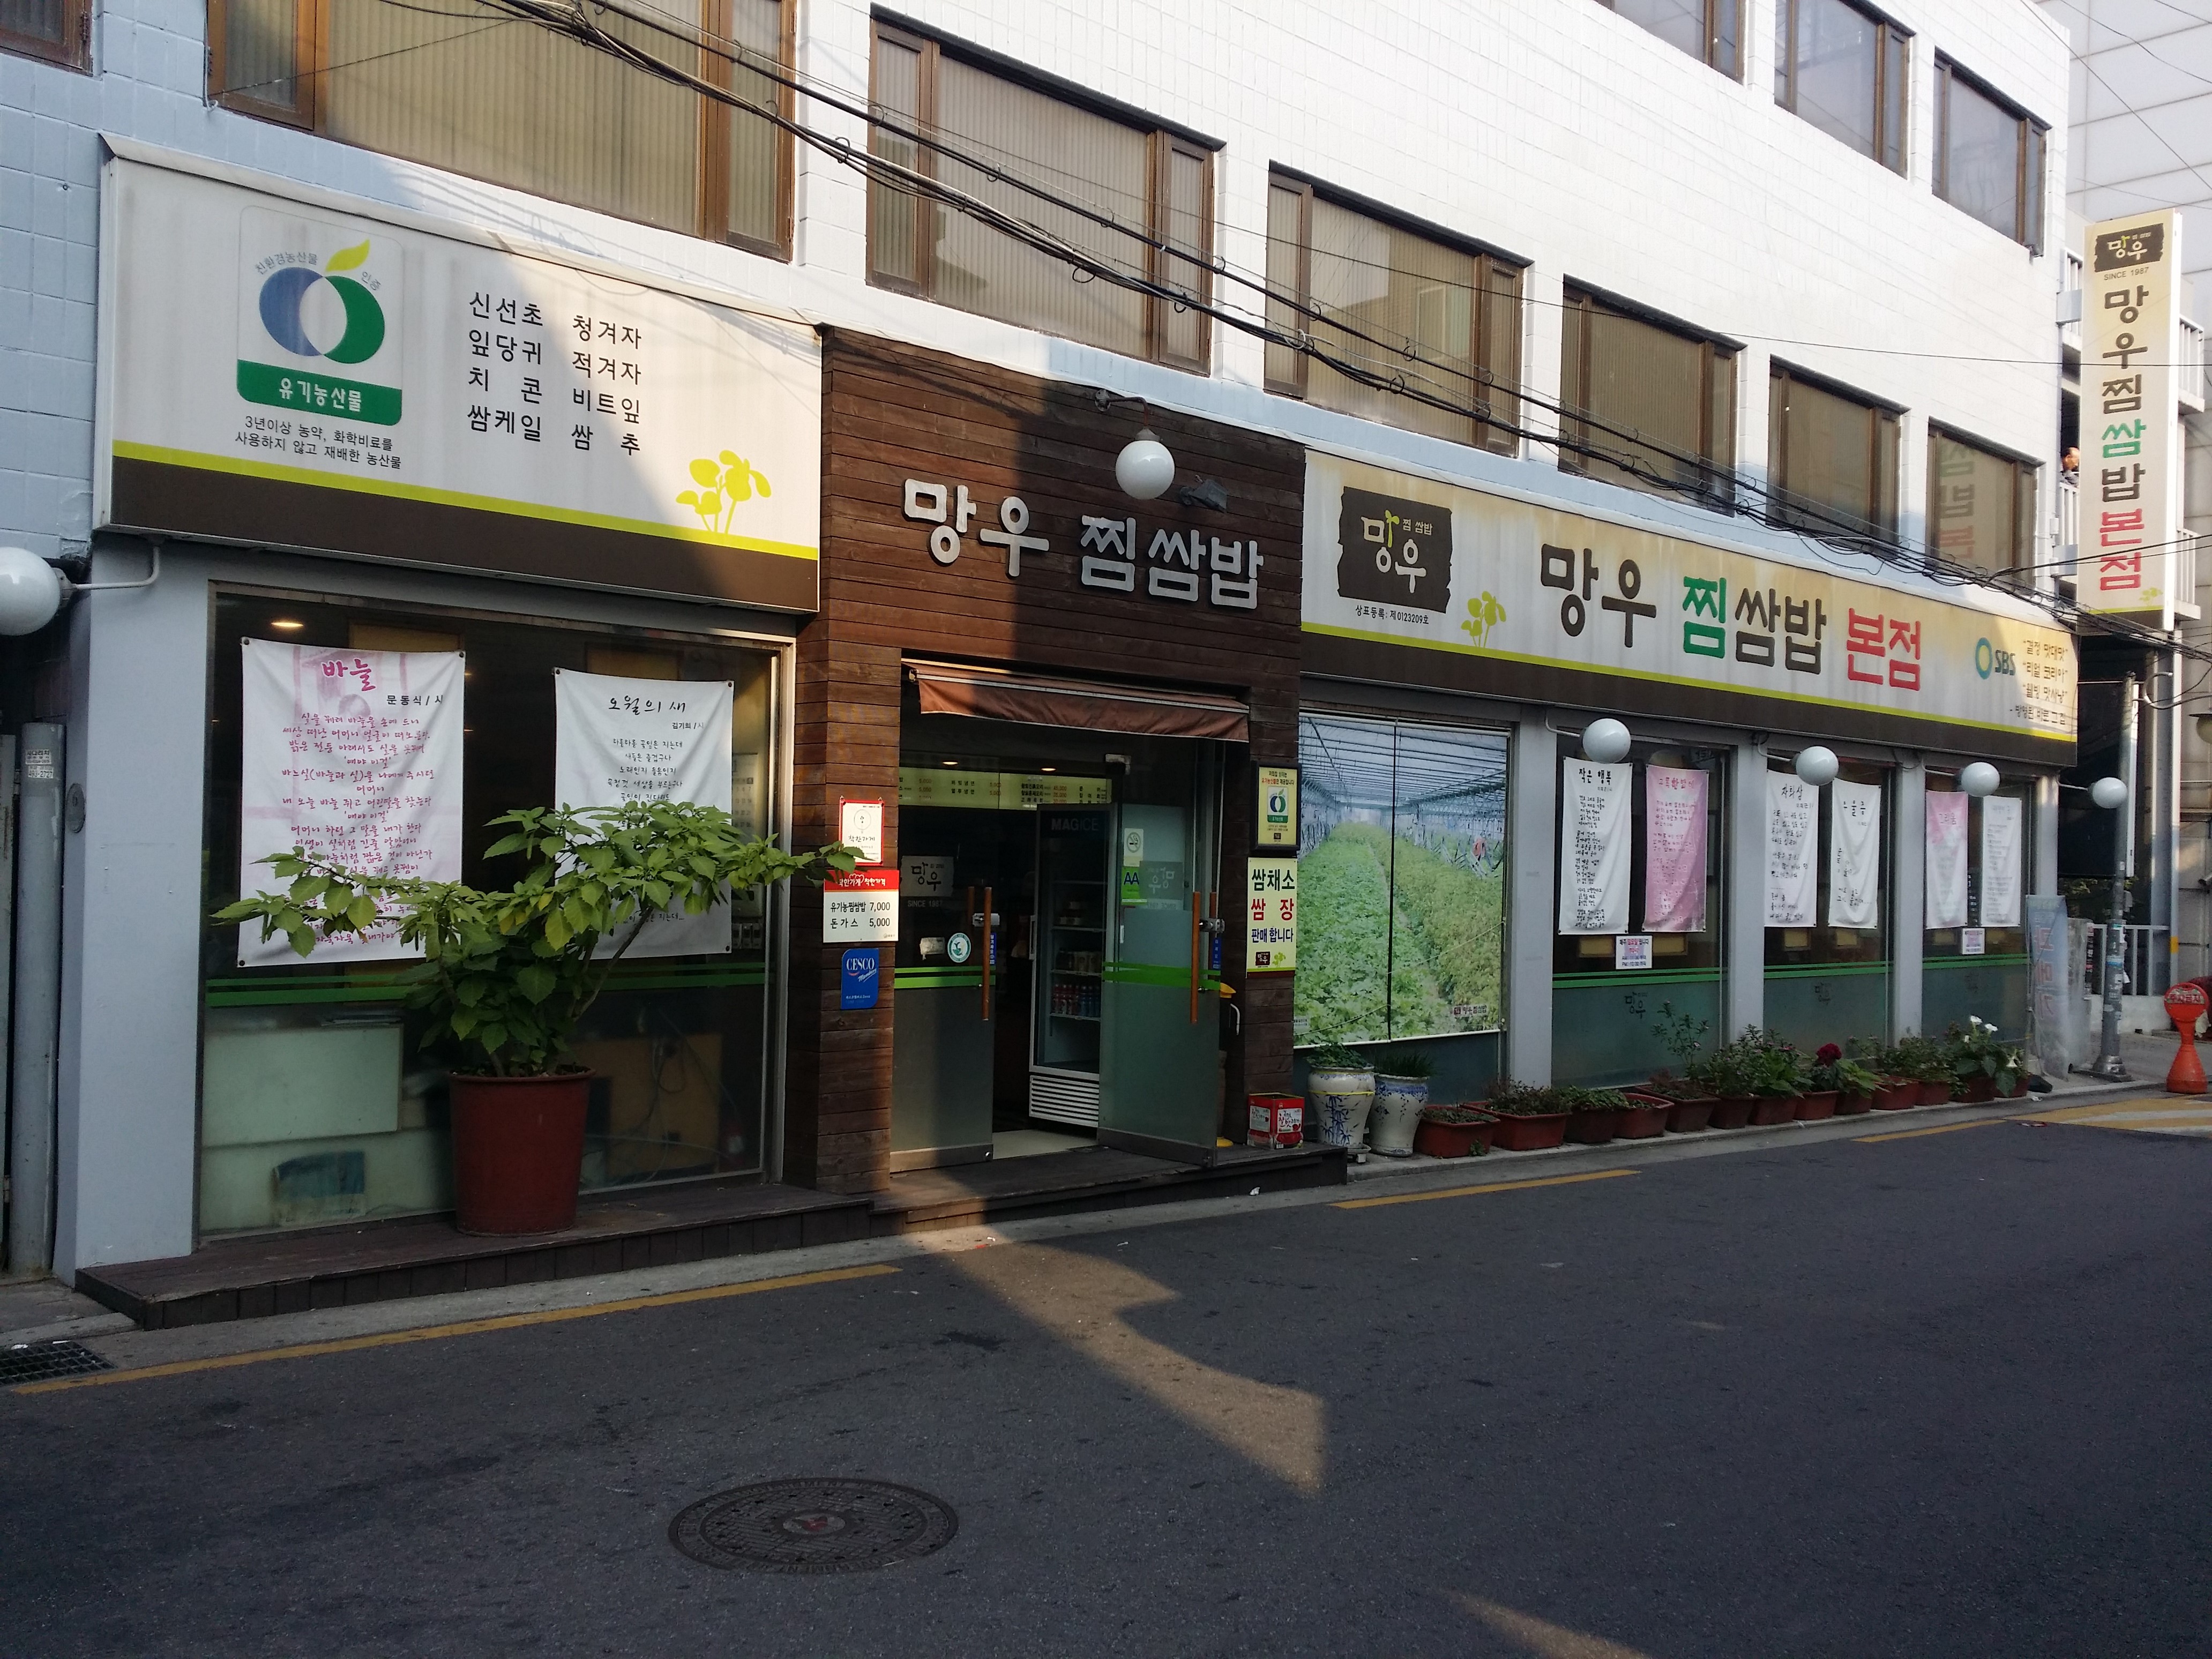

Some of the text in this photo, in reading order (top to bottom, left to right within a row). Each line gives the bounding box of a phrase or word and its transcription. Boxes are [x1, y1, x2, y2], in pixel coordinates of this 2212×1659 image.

[2108, 235, 2147, 260] 망우
[2104, 267, 2149, 280] SINCE 1987
[469, 292, 642, 350] 신선초 청겨자
[469, 329, 642, 386] 잎당귀 적겨자
[279, 377, 363, 413] 유기농산물
[573, 388, 641, 425] 비트잎
[245, 415, 393, 451] 3년이상 농약, 화학비료를
[467, 405, 541, 443] 쌈케일
[235, 432, 402, 471] 사용하지 않고 재배한 농산물
[1402, 518, 1433, 536] 찜 쌈밥
[905, 479, 1264, 609] 망우 찜쌈밥
[1361, 510, 1427, 594] 망우
[1355, 604, 1430, 625] 상표등록: 제0123209호
[1541, 543, 1922, 692] 망우 찜쌈밥 본점
[1994, 649, 2016, 676] SBS
[322, 659, 377, 692] 바늘
[608, 695, 686, 716] 오월의 새
[1579, 767, 1611, 786] 작은 행복
[356, 784, 385, 795] 어머니
[1051, 818, 1098, 831] MAGICE
[848, 834, 876, 843] 착한가게
[911, 862, 941, 892] 망우
[1123, 872, 1140, 885] AA
[1251, 869, 1296, 892] 쌈채소
[830, 901, 891, 913] 유기농찜쌈밥 7,000
[1251, 898, 1295, 921] 쌈 장
[869, 918, 891, 928] 5,000
[846, 958, 875, 971] CESCO
[857, 968, 877, 982] Members
